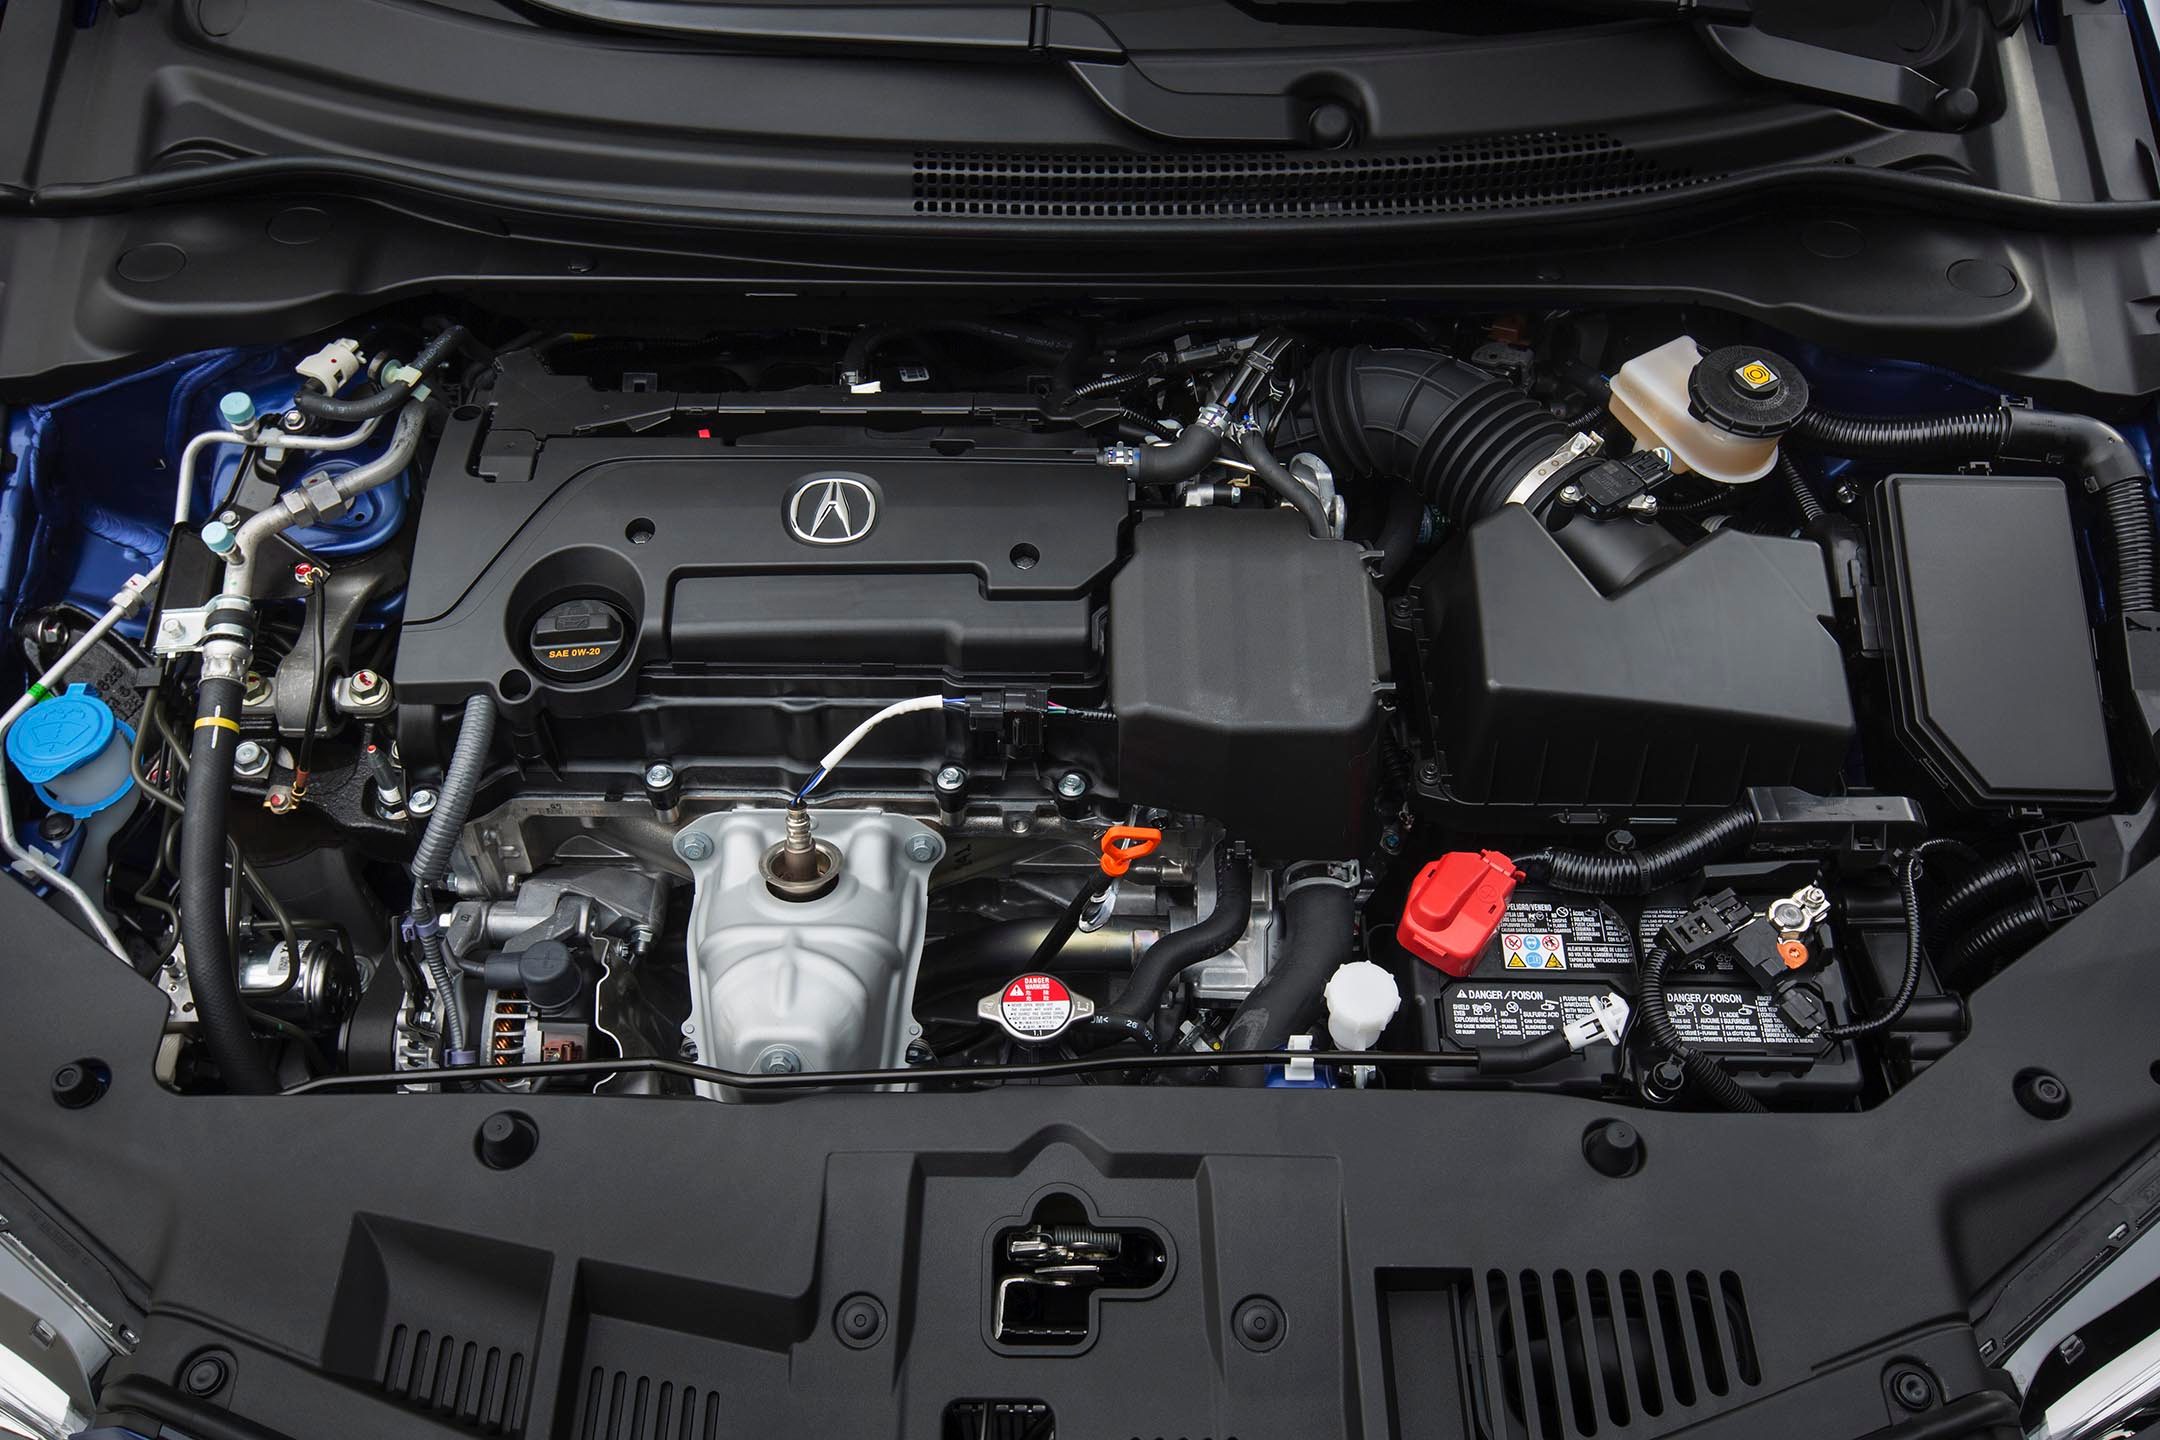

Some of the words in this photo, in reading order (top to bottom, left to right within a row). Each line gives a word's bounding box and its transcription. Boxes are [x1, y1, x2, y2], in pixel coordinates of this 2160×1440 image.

[549, 650, 569, 658] SAE
[572, 648, 601, 656] 0W-20
[1468, 989, 1504, 1000] DANGER
[1511, 990, 1544, 1001] POISON
[1666, 993, 1702, 1003] DANGER
[1710, 994, 1743, 1004] POISON
